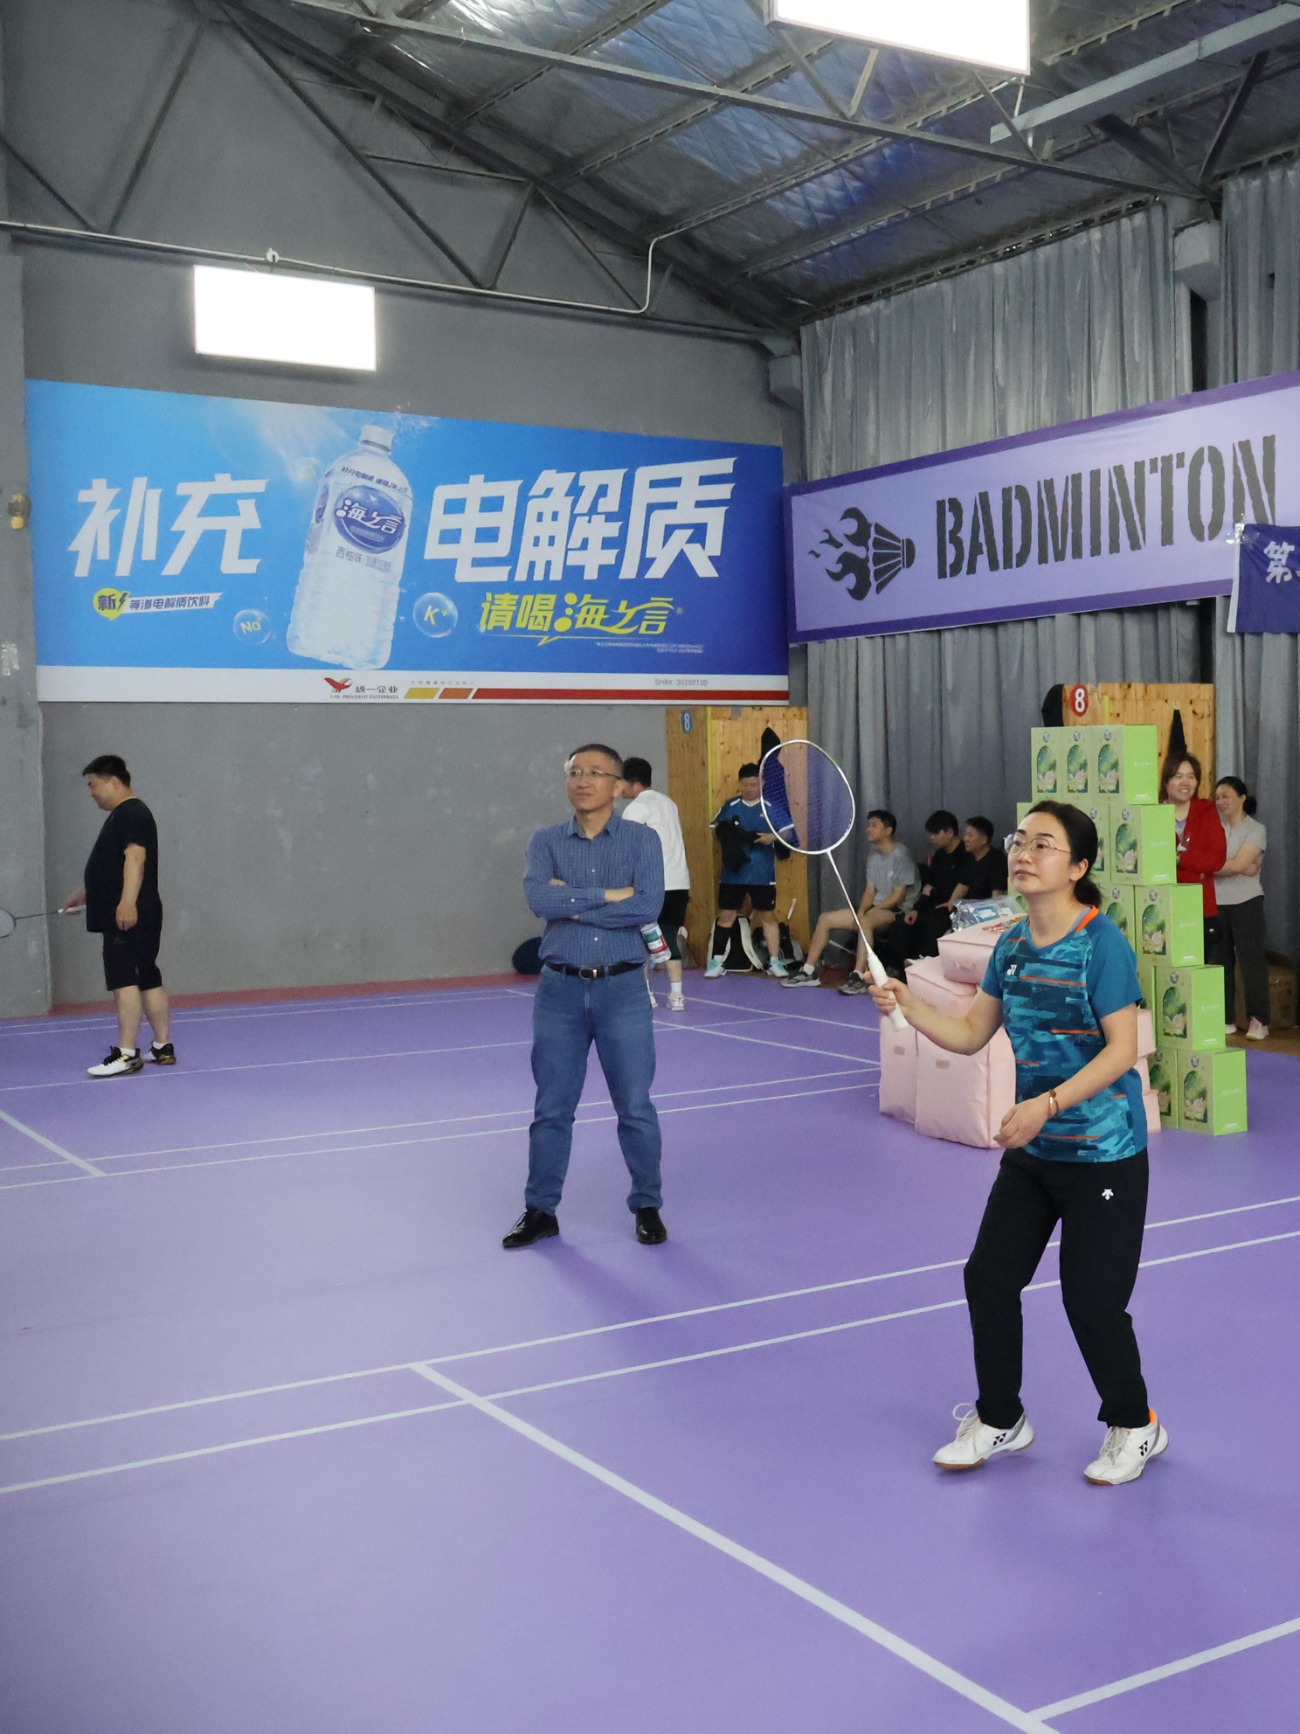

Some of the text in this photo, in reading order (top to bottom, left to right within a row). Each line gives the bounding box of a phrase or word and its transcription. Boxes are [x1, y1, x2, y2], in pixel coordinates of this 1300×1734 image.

[67, 472, 271, 578] 补充
[423, 457, 740, 583] 电解质
[936, 434, 1276, 579] BADMINTON
[98, 594, 116, 611] 新
[1074, 688, 1086, 713] 8
